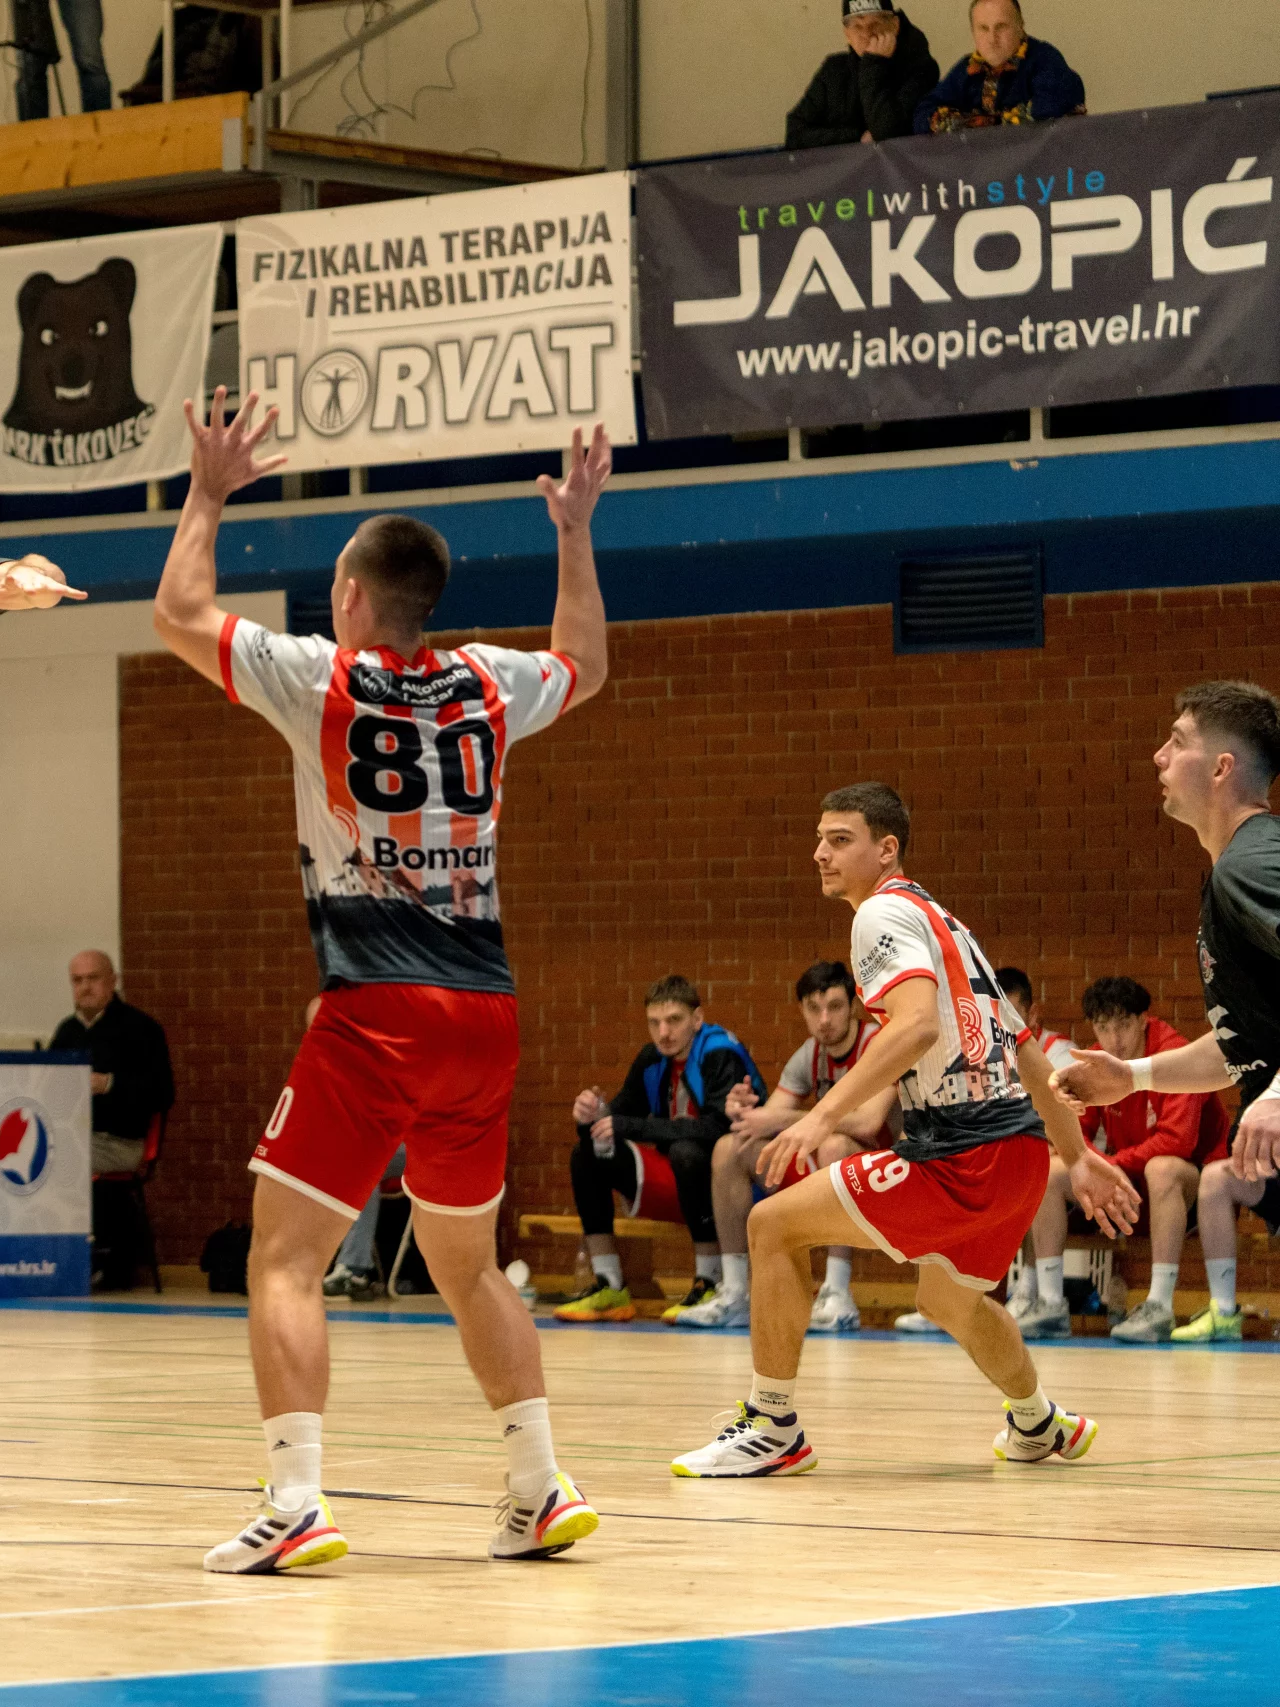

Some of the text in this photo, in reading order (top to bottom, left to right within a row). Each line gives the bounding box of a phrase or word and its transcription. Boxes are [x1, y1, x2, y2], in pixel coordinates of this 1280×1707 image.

[252, 210, 613, 283] FIZIKALNA TERAPIJA
[673, 156, 1273, 327] JAKOPIĆ
[306, 252, 614, 318] I REHABILITACIJA
[737, 302, 1201, 379] www.jakopic-travel.hr
[247, 322, 615, 442] HORVAT
[346, 714, 497, 815] 80
[372, 837, 494, 871] Bomar
[858, 945, 880, 969] IENER
[860, 946, 898, 978] SIGURANJE
[265, 1086, 294, 1140] 0
[861, 1150, 910, 1193] 19
